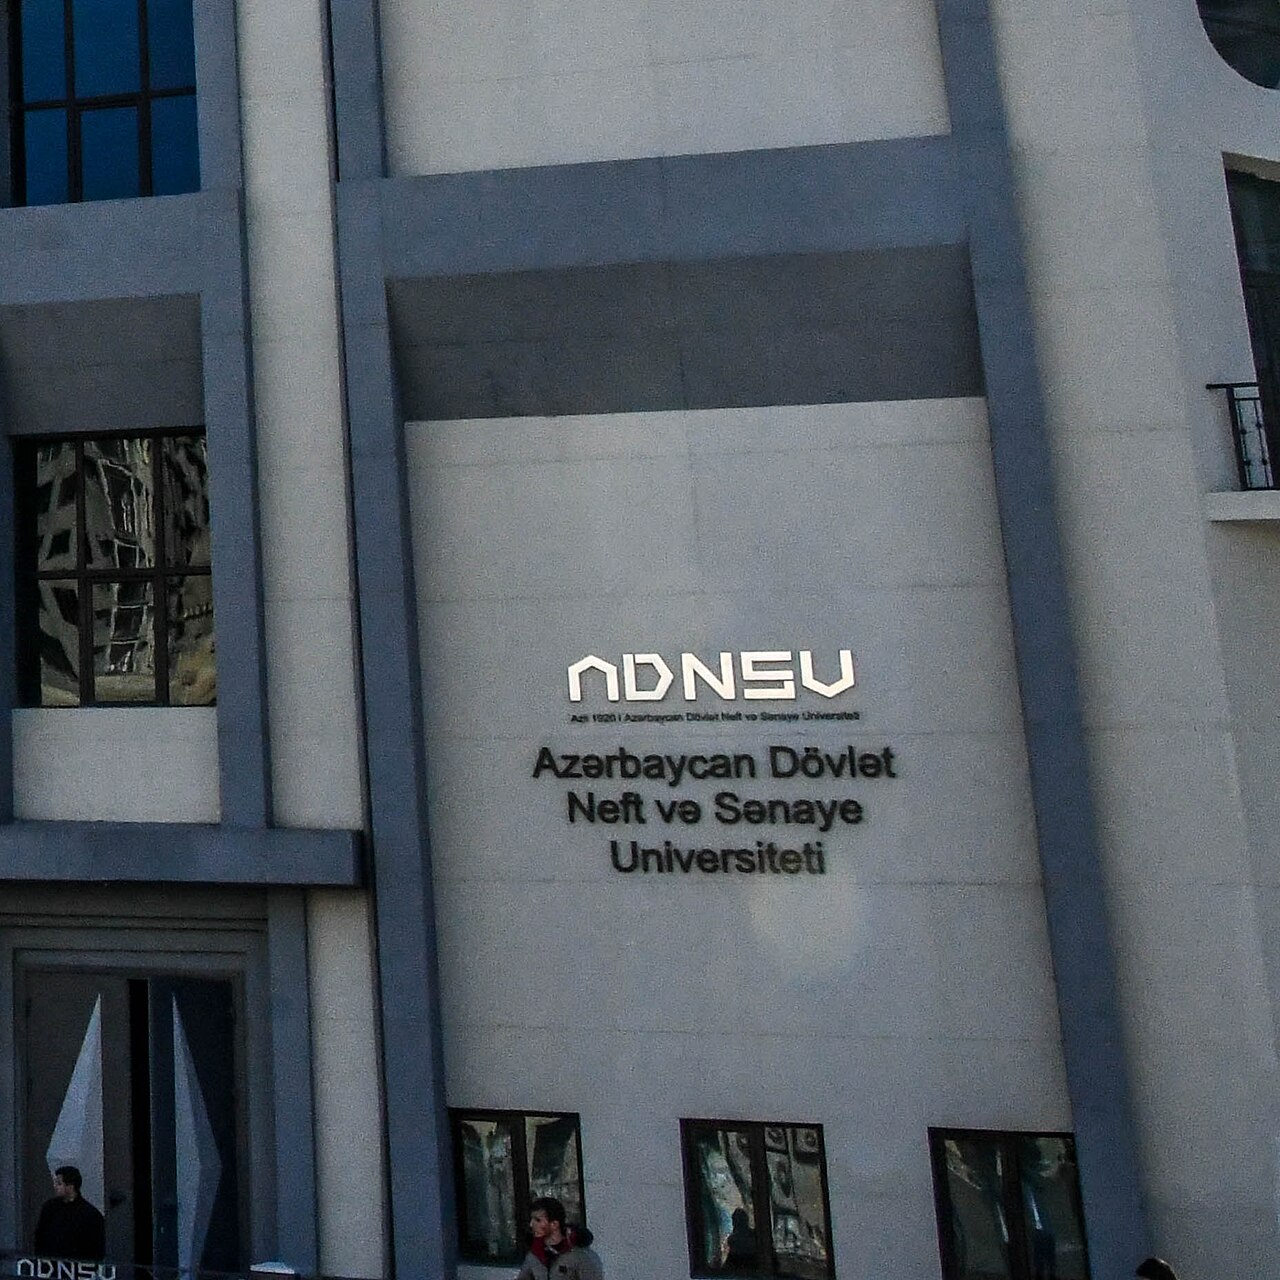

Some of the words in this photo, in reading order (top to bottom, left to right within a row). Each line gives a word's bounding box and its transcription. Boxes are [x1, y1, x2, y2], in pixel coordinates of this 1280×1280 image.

[532, 746, 757, 788] Azərbaycan
[768, 745, 897, 779] Dövlət
[566, 791, 646, 825] Neft
[654, 798, 703, 825] və
[714, 792, 864, 833] Sənaye
[609, 840, 826, 875] Universiteti
